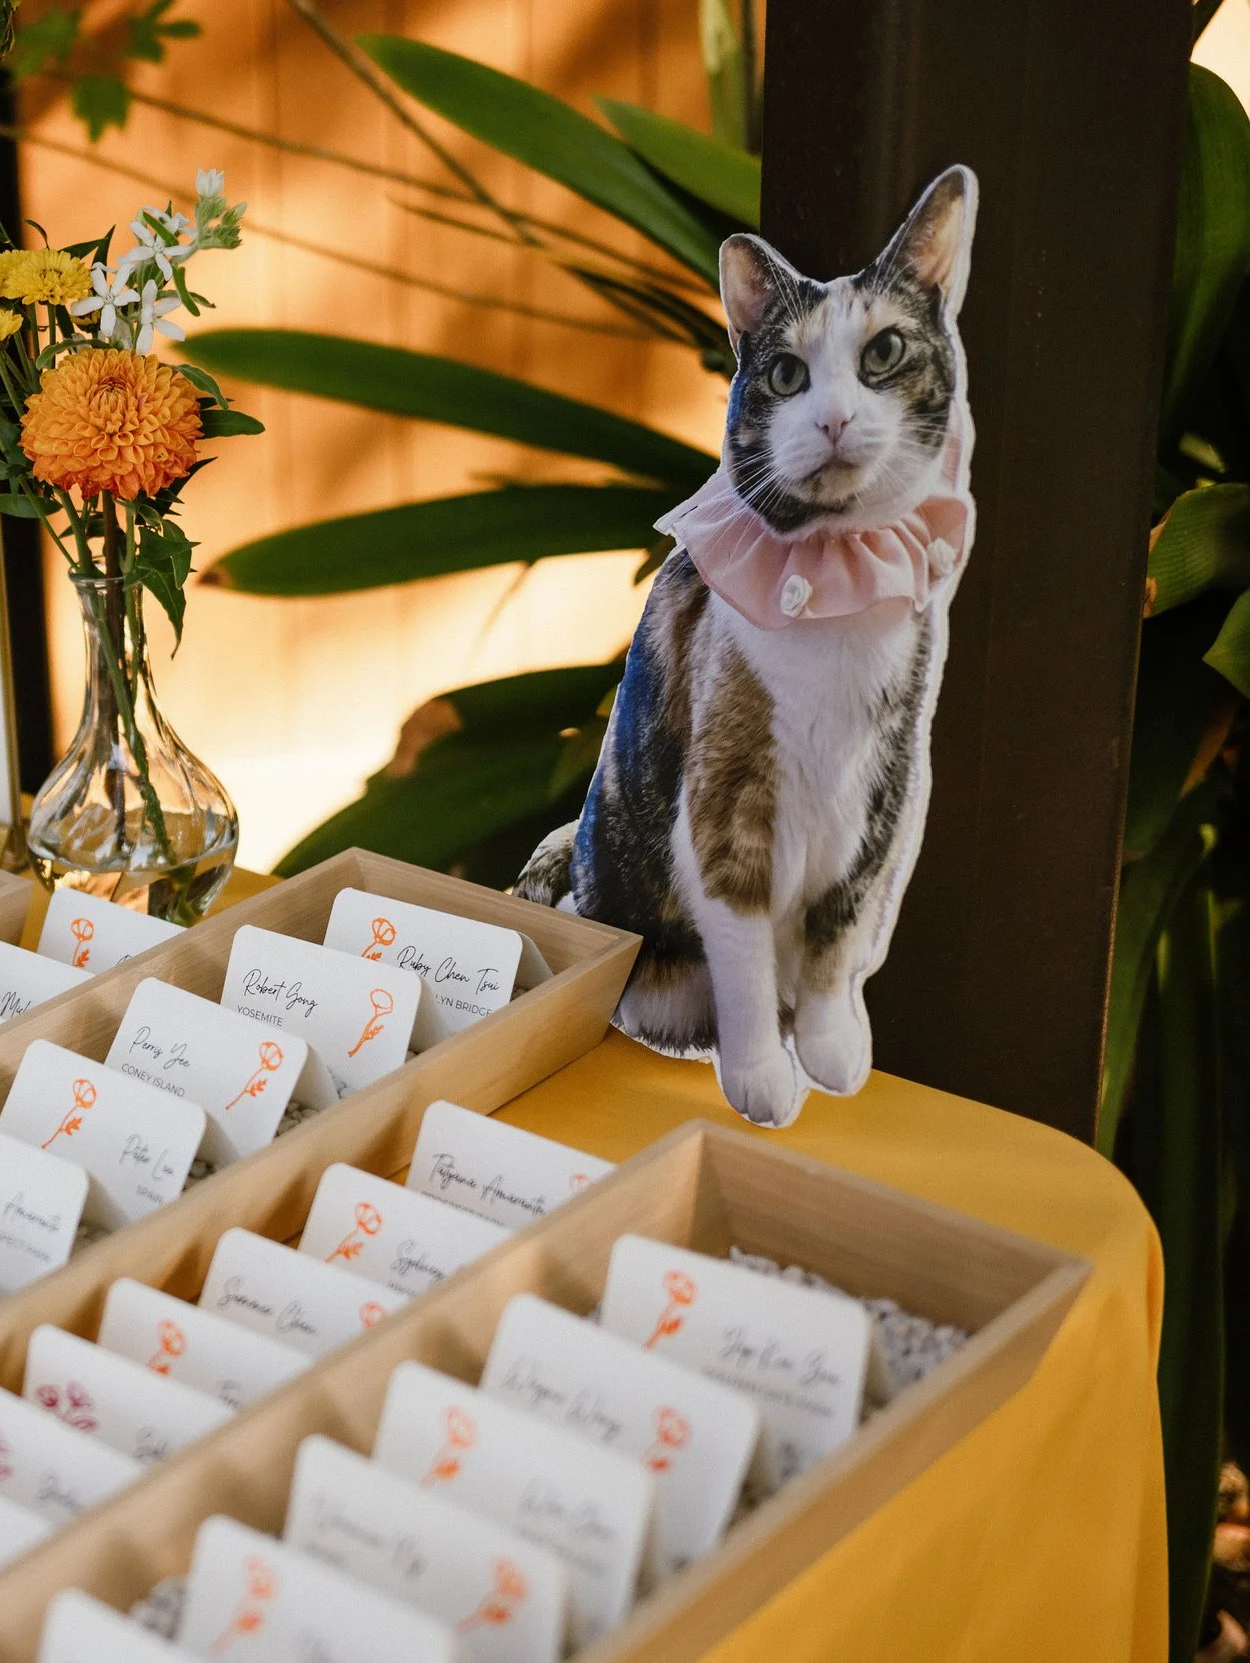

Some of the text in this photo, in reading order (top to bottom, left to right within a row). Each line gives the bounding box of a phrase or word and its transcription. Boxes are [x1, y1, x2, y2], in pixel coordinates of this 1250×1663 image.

[397, 945, 500, 996] Ruby Chen Tsui
[242, 968, 318, 1018] Robert Gong
[237, 1005, 284, 1027] YOSEMITE
[129, 1026, 191, 1070] Perry Yee
[121, 1063, 185, 1098] CONEY ISLAND
